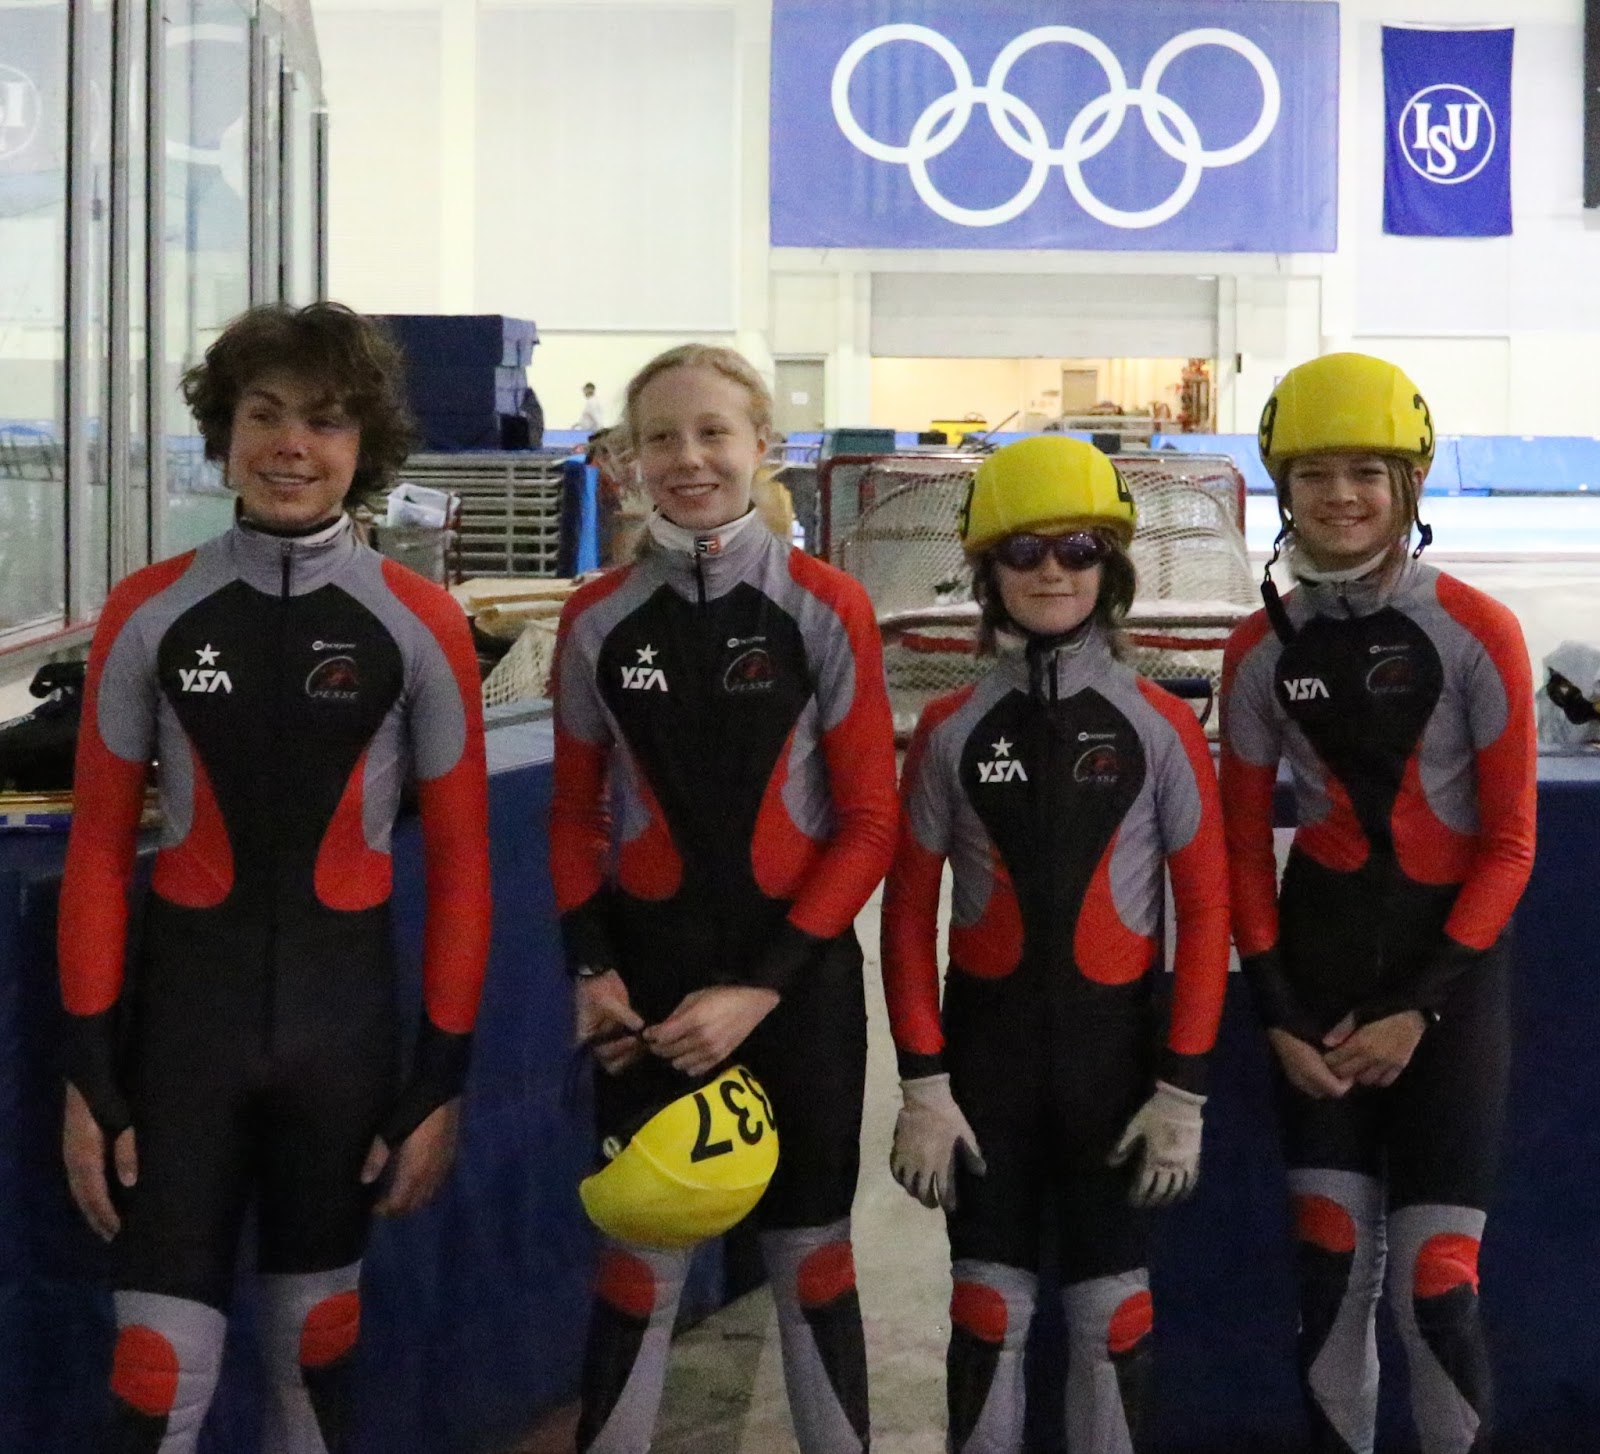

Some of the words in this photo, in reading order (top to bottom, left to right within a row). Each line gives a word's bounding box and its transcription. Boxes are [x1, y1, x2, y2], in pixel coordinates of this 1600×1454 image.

[1411, 102, 1482, 176] ISU
[178, 668, 233, 694] YSA
[620, 666, 669, 692] YSA
[1283, 678, 1330, 700] YSA
[977, 759, 1029, 783] YSA
